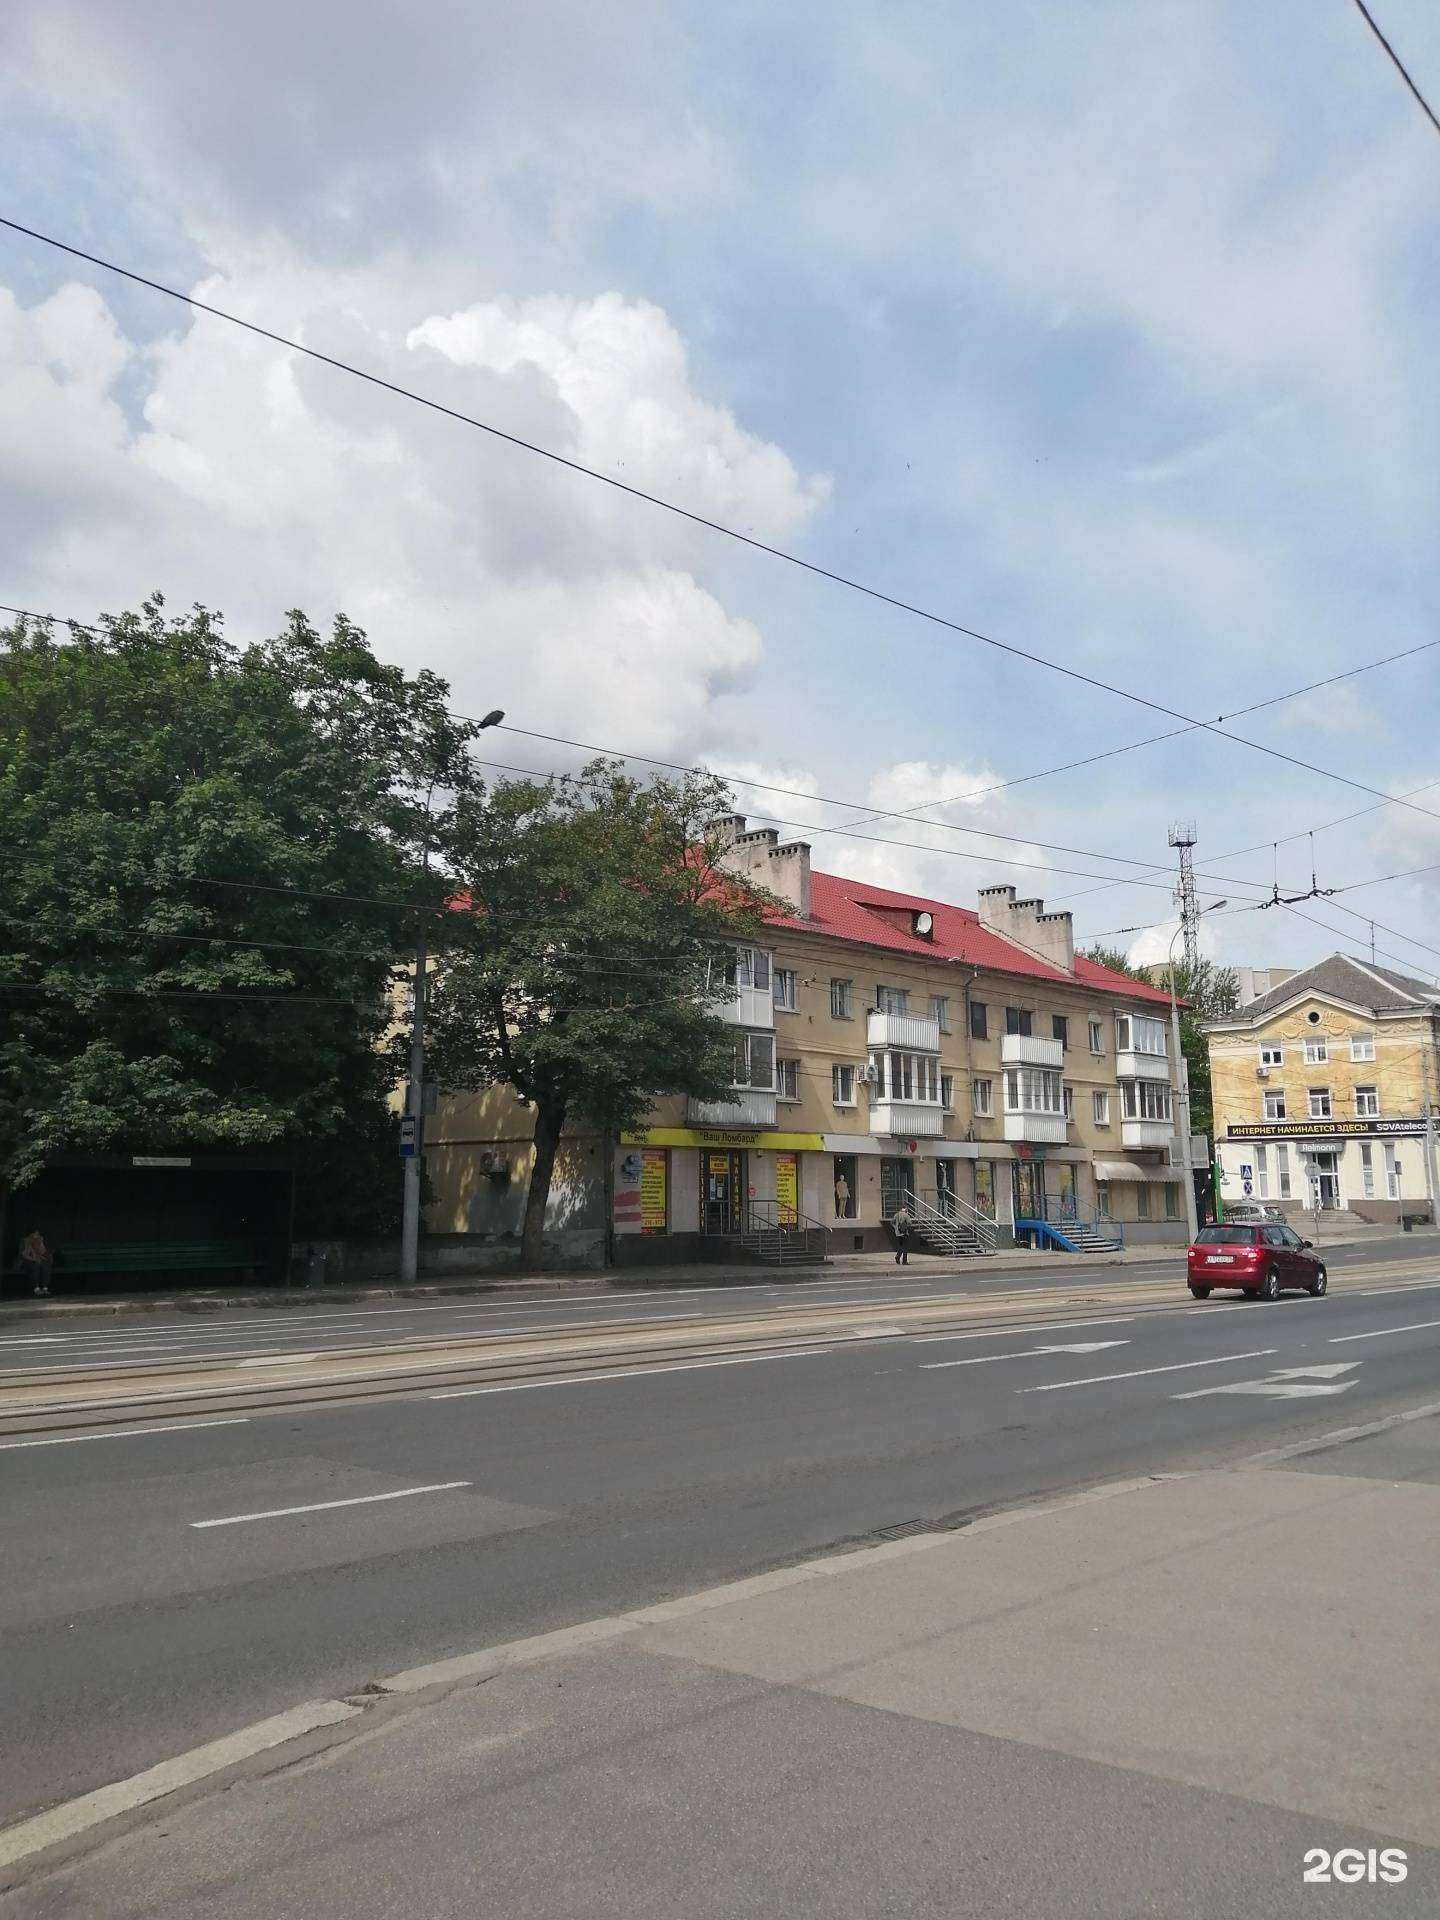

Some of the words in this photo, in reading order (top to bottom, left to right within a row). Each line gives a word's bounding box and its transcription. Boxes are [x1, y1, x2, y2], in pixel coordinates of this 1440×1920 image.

[1232, 1127, 1276, 1135] ИНТЕРНЕТ
[1277, 1125, 1335, 1134] НАЧИНАЕТСЯ
[1336, 1123, 1369, 1133] ЗДЕСЬ!
